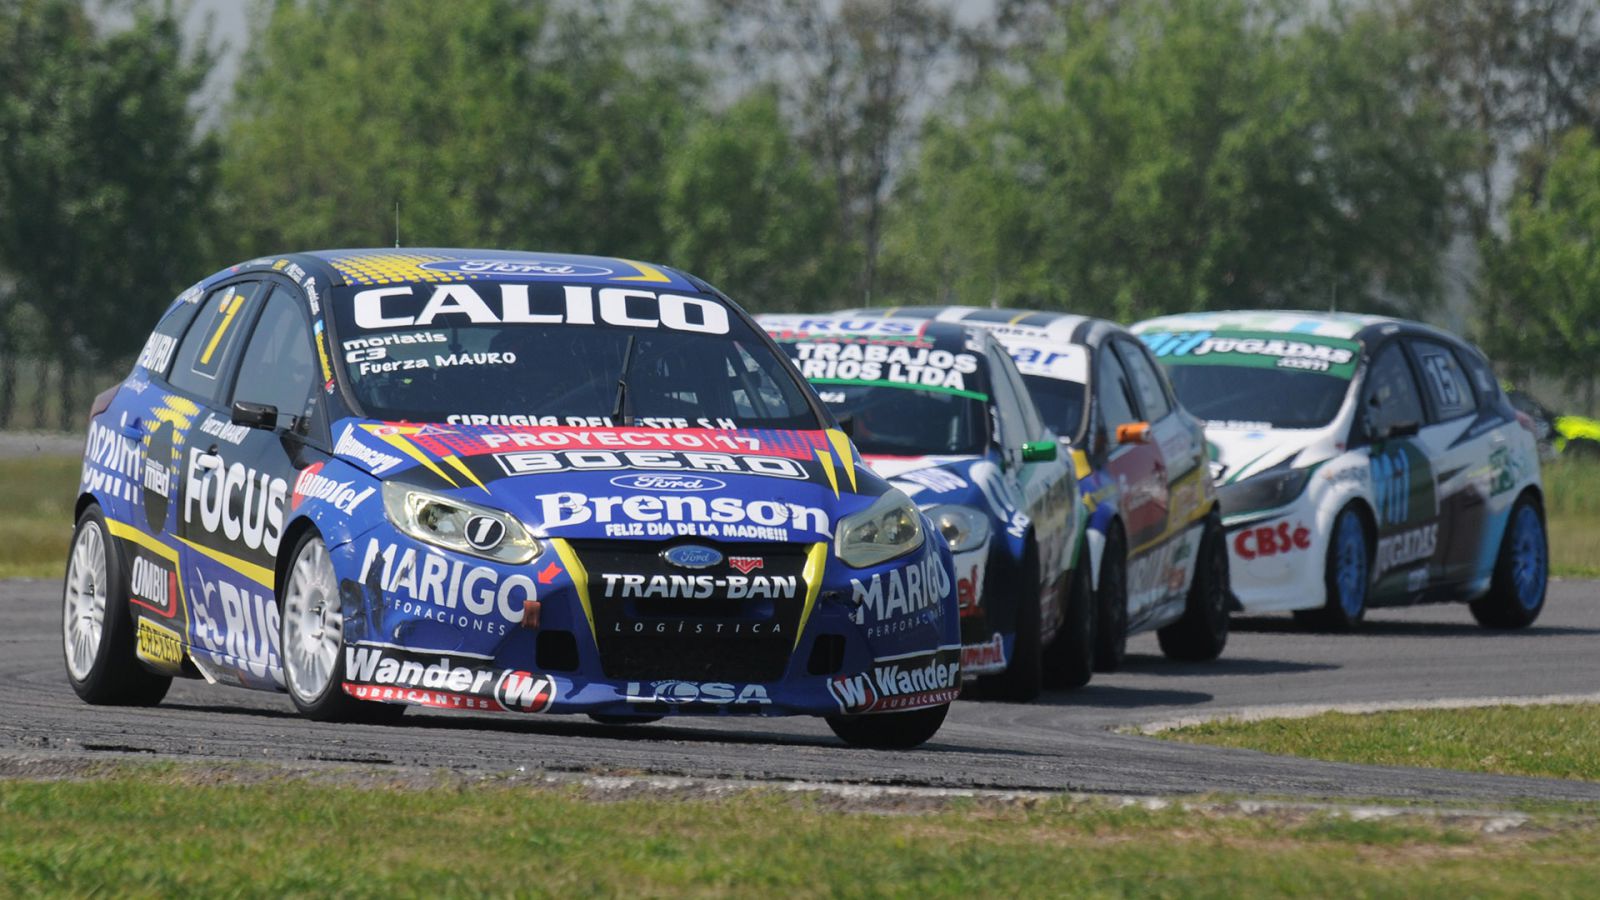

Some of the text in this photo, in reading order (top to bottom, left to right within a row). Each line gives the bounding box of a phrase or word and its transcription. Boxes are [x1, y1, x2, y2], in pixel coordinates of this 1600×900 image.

[460, 261, 575, 275] Ford
[354, 284, 730, 335] CALICO
[800, 319, 915, 333] RUS
[343, 332, 447, 351] moriatis
[345, 347, 387, 363] C3
[359, 352, 517, 376] Fuerza MAURO
[796, 342, 978, 374] TRABAJOS
[889, 362, 965, 391] LTDA
[503, 451, 801, 478] BOERO
[634, 475, 704, 490] Ford
[184, 447, 287, 557] FOCUS
[535, 492, 834, 540] Brenson
[473, 517, 497, 544] 1
[605, 523, 788, 541] FELIZ DIA DE LA MADRE!!!
[680, 548, 711, 563] Ford
[730, 557, 764, 574] RIVA
[131, 555, 169, 607] OMBU
[359, 538, 537, 623] MARIGO
[602, 573, 797, 599] TRANS-BAN
[851, 552, 951, 625] MARIGO
[614, 619, 782, 633] LOGÍSTICA
[345, 646, 494, 694] Wander
[874, 658, 960, 696] Wander
[345, 685, 489, 709] LUBRICANTES
[501, 673, 550, 707] W
[626, 681, 773, 704] LOSA
[834, 673, 868, 708] W
[881, 689, 960, 709] LUBRICANTES
